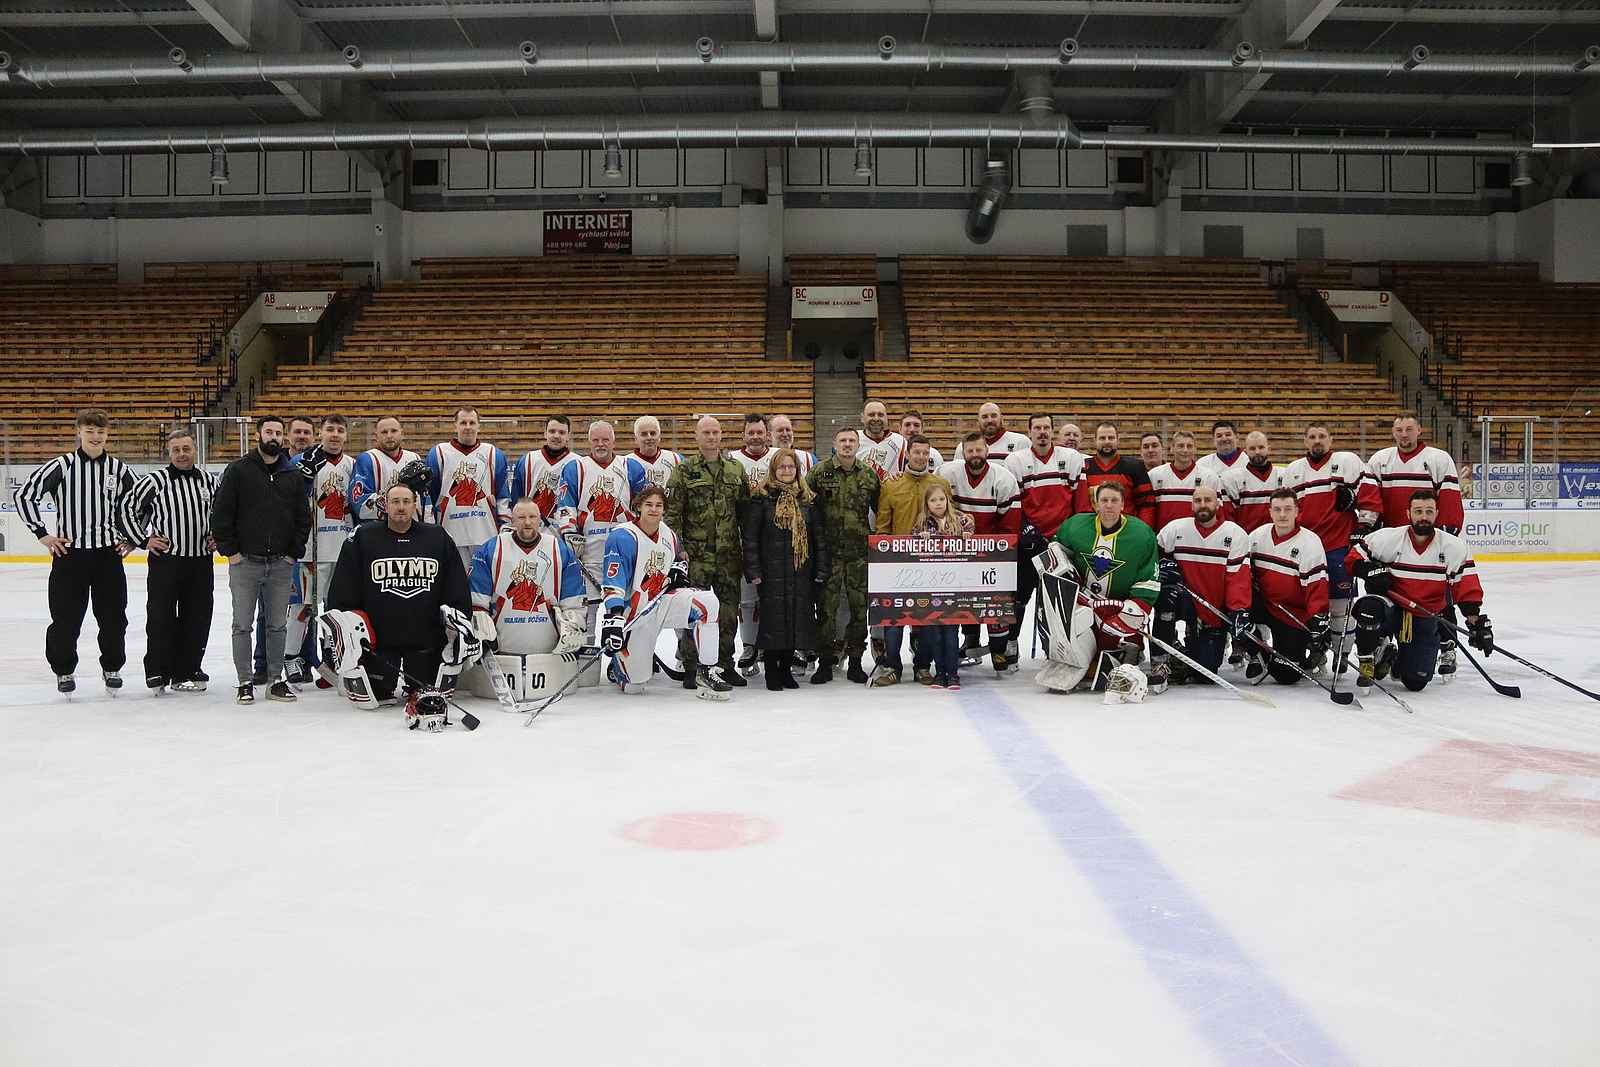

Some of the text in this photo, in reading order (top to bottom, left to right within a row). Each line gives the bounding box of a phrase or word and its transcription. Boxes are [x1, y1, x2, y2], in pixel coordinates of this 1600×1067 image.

[546, 213, 630, 230] INTERNET
[264, 293, 276, 305] AB
[795, 288, 807, 299] BC
[862, 288, 874, 299] CD
[1379, 292, 1390, 304] D
[1491, 466, 1553, 475] CELLOOAM
[892, 539, 995, 552] BENEFICE PRO EDIHO
[374, 560, 437, 580] OLYMP
[607, 562, 619, 577] 5
[982, 568, 996, 585] KČ
[385, 578, 428, 588] PRAGUE
